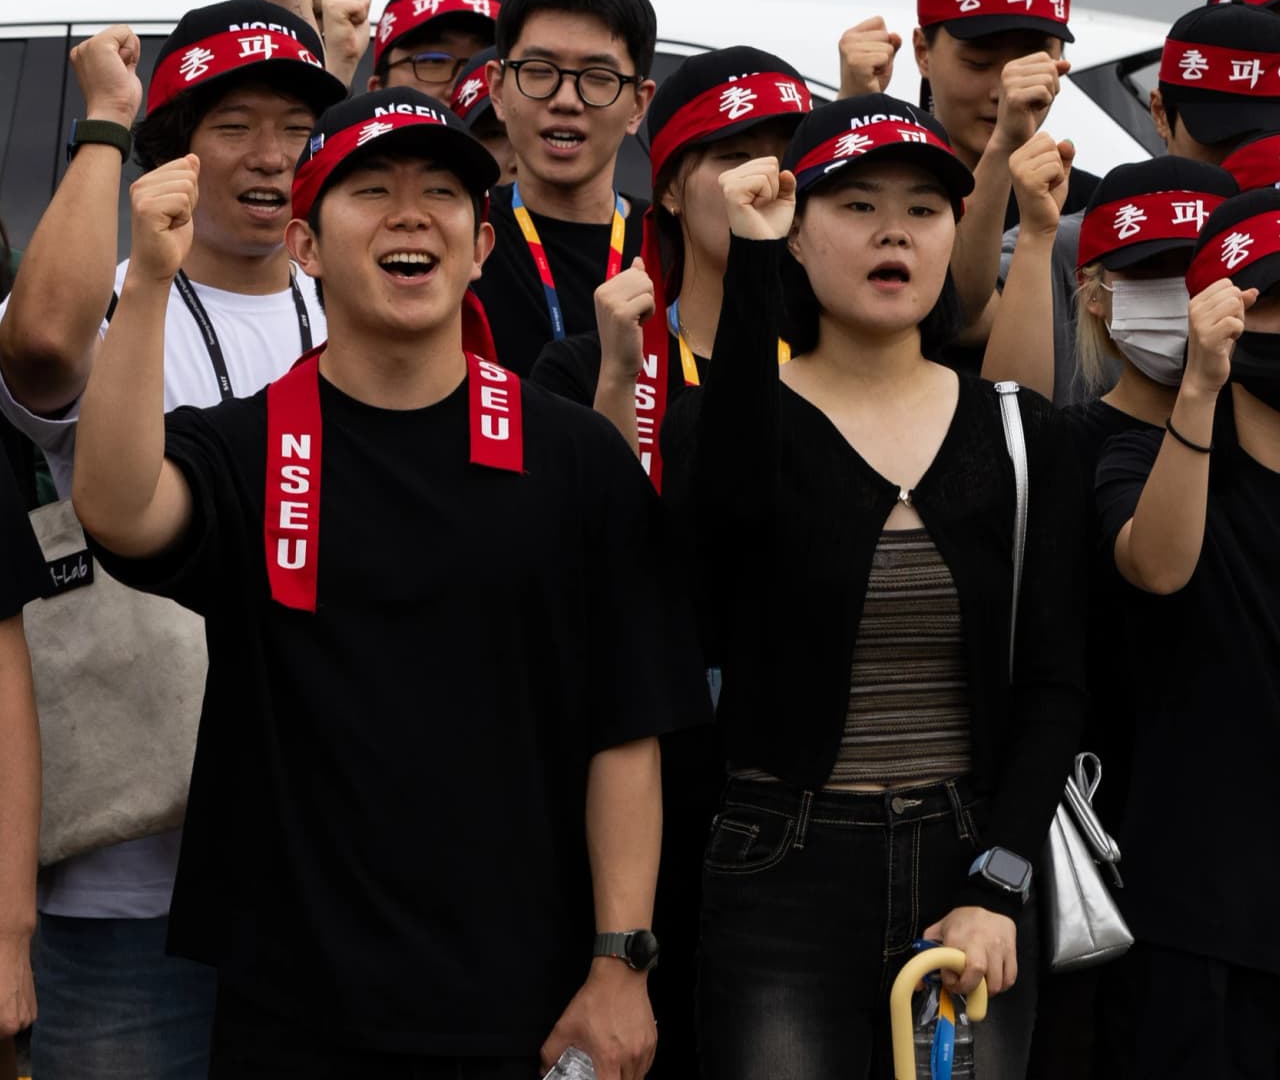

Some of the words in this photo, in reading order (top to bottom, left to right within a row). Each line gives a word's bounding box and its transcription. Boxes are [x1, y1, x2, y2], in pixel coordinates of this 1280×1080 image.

[720, 82, 813, 119] 총파
[476, 356, 509, 440] SEU
[278, 434, 310, 569] NSEU
